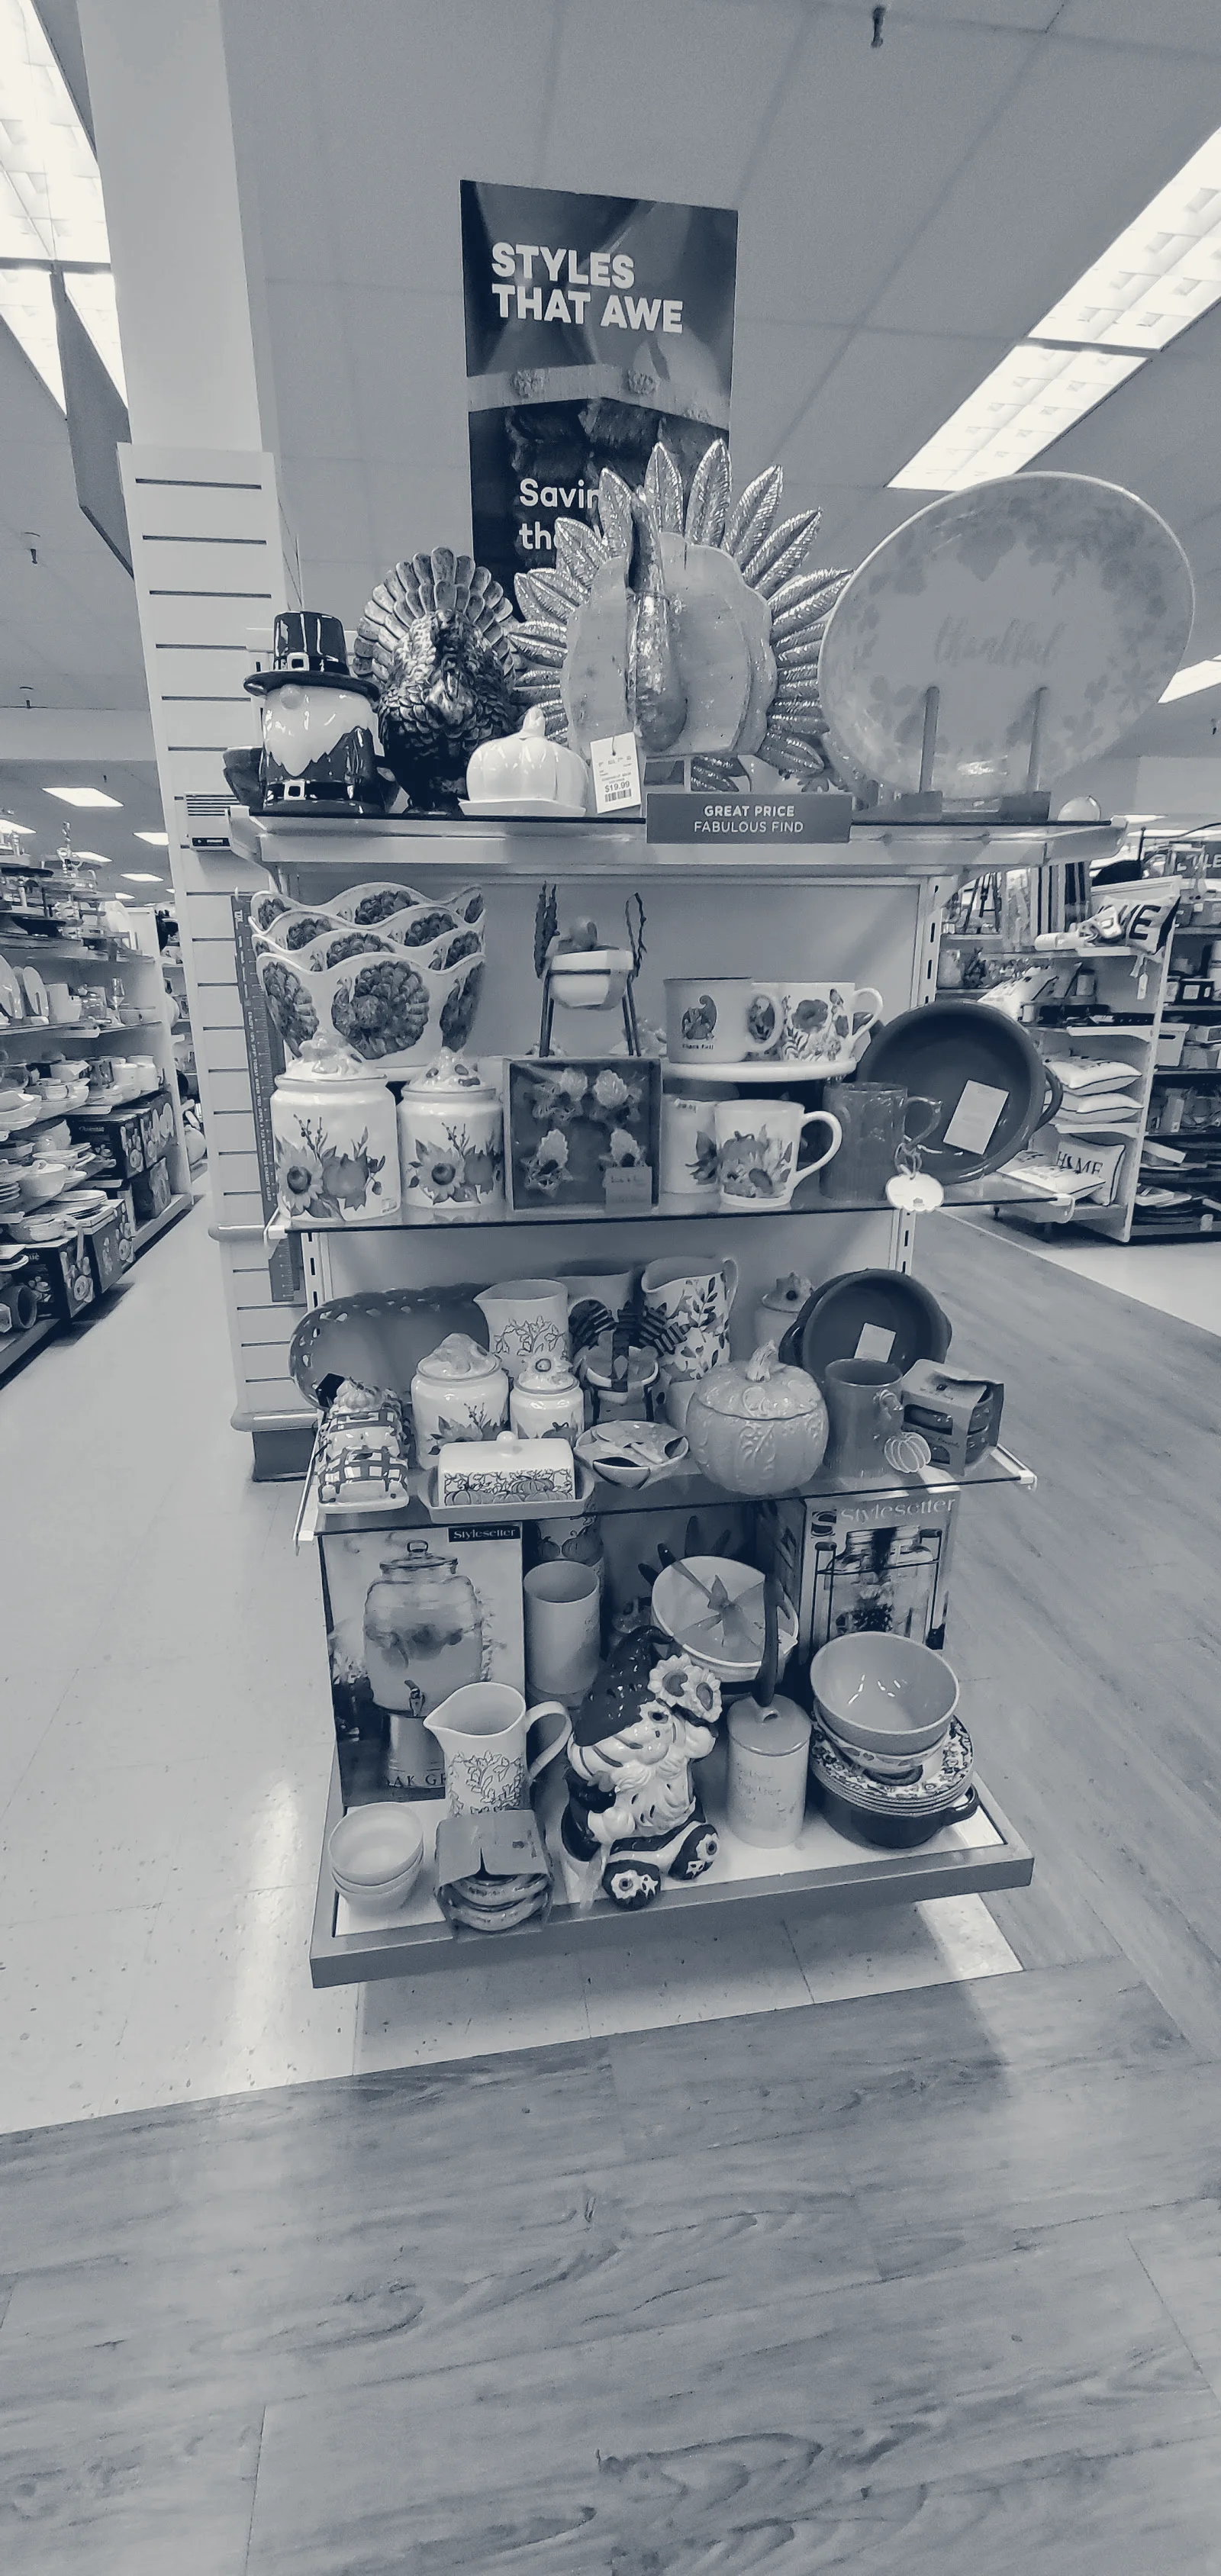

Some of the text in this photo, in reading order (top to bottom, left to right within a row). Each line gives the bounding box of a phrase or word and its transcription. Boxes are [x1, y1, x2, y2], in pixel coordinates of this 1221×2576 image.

[491, 242, 635, 289] STYLES
[492, 283, 684, 333] THAT AWE
[604, 781, 630, 793] $19.99
[704, 805, 795, 817] GREAT PRICE
[694, 821, 804, 833] FABULOUS FIND
[841, 1498, 955, 1525] Stylesetter
[453, 1528, 516, 1541] Stylesetter
